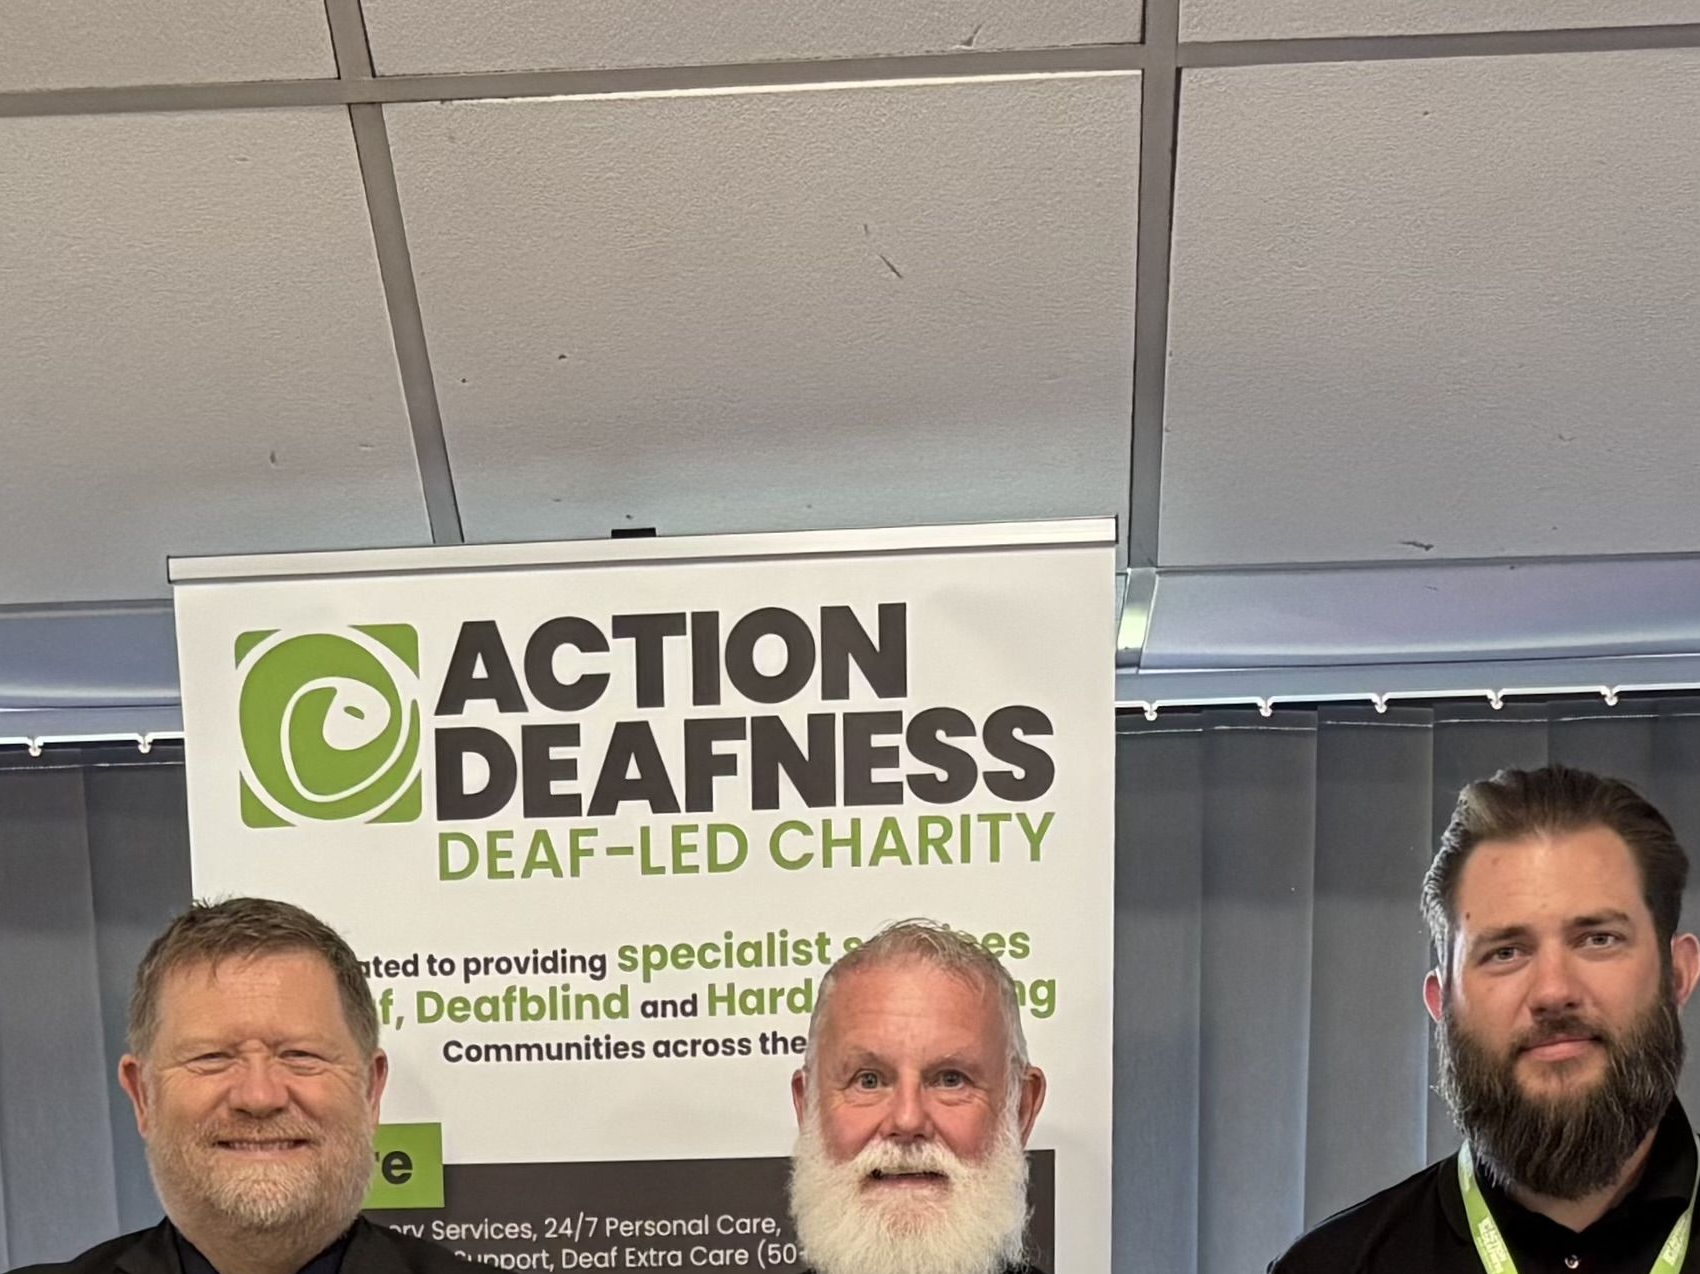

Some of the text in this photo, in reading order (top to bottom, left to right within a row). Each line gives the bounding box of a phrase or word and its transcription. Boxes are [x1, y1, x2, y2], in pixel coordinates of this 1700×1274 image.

[434, 602, 907, 715] ACTION
[434, 706, 1055, 820] DEAFNESS
[439, 812, 1055, 882] DEAF-LED CHARITY
[426, 953, 454, 980] to
[463, 949, 607, 983] providing
[617, 934, 831, 975] specialist
[416, 989, 630, 1026] Deafblind
[642, 991, 697, 1020] and
[706, 981, 816, 1017] Hard
[443, 1033, 806, 1065] Communities across the
[432, 1219, 537, 1241] Services,
[545, 1212, 597, 1241] 24/7
[605, 1215, 709, 1237] Personal
[717, 1214, 780, 1236] Care,
[562, 1246, 749, 1269] Deaf Extra Care
